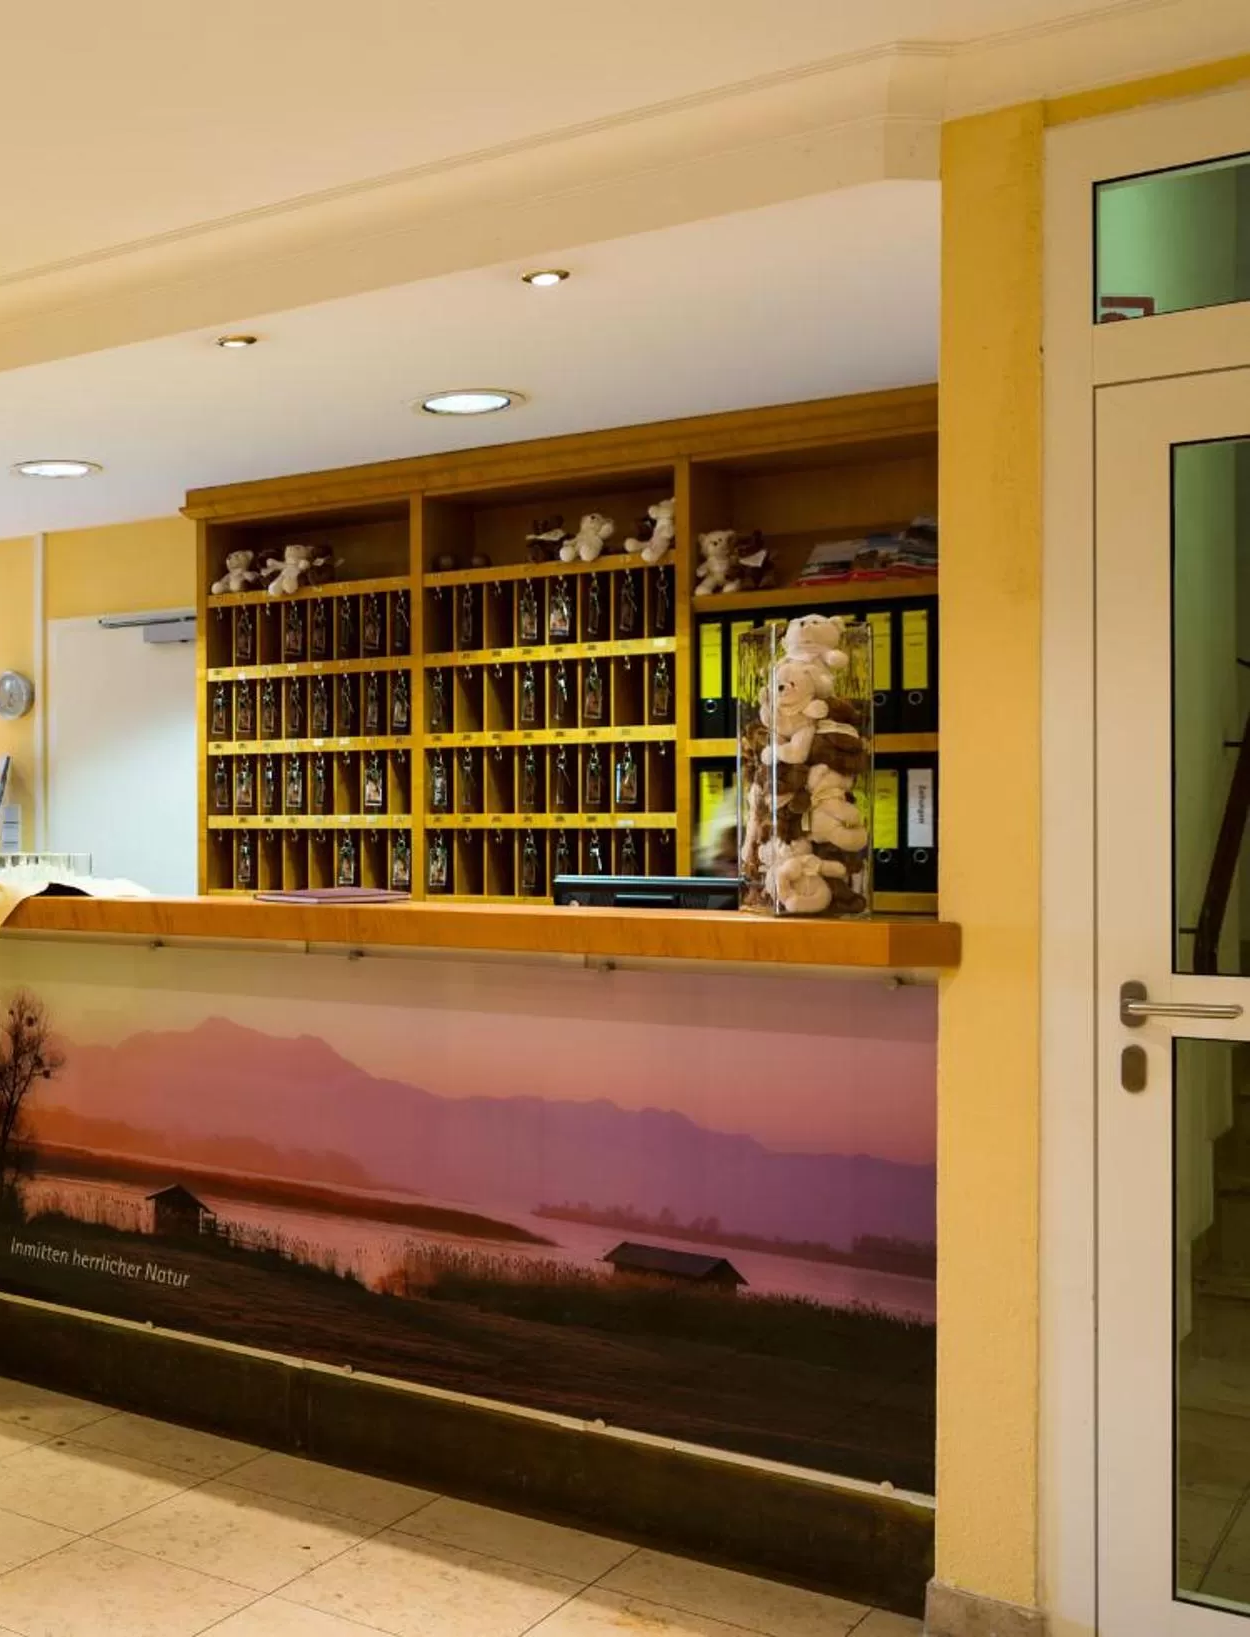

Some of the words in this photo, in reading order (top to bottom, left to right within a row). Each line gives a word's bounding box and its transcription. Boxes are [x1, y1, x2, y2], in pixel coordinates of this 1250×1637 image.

[10, 1236, 69, 1265] Inmitten
[72, 1249, 142, 1279] herrlicher
[144, 1262, 191, 1288] Natur
